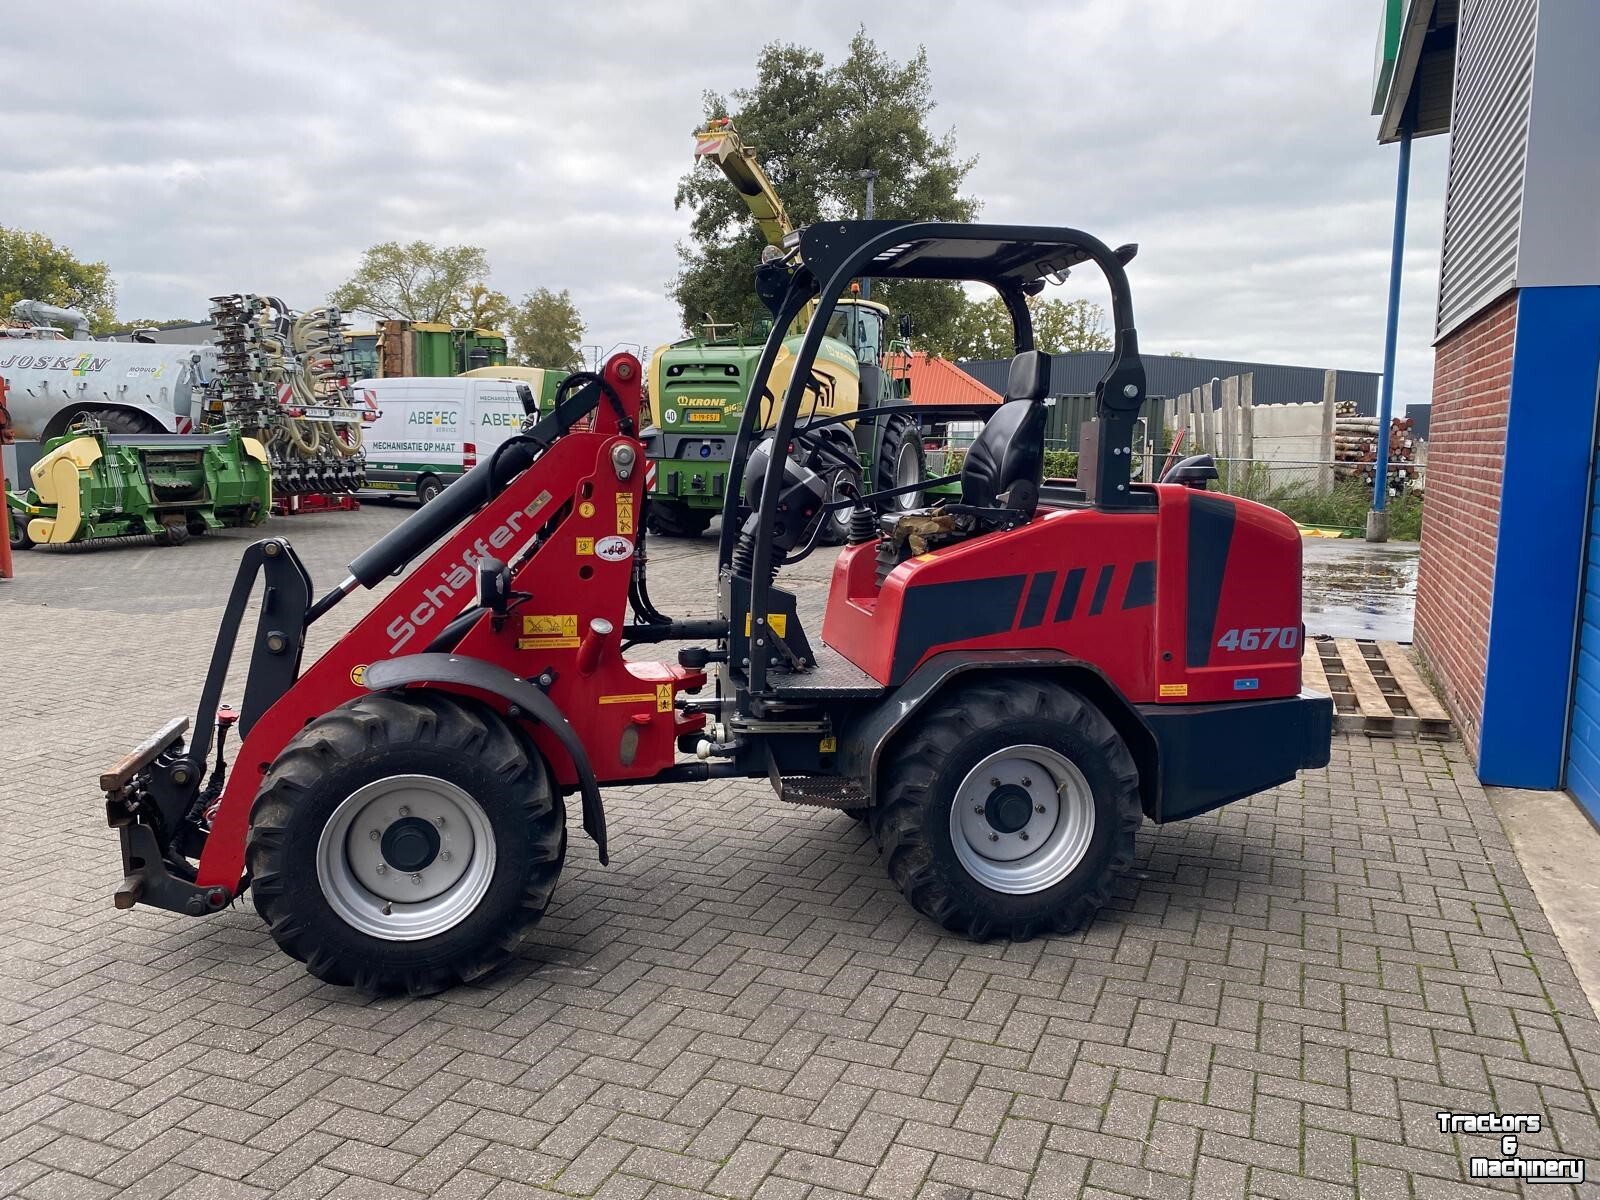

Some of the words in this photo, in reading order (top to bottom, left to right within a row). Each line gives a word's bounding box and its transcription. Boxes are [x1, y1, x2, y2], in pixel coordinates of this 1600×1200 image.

[1, 353, 111, 372] JOSKIN
[688, 398, 727, 406] KRONE
[666, 411, 675, 421] 40
[373, 442, 422, 450] MECHANISATIE
[424, 442, 433, 451] OP
[435, 443, 455, 452] MAAT
[1217, 627, 1298, 651] 4670
